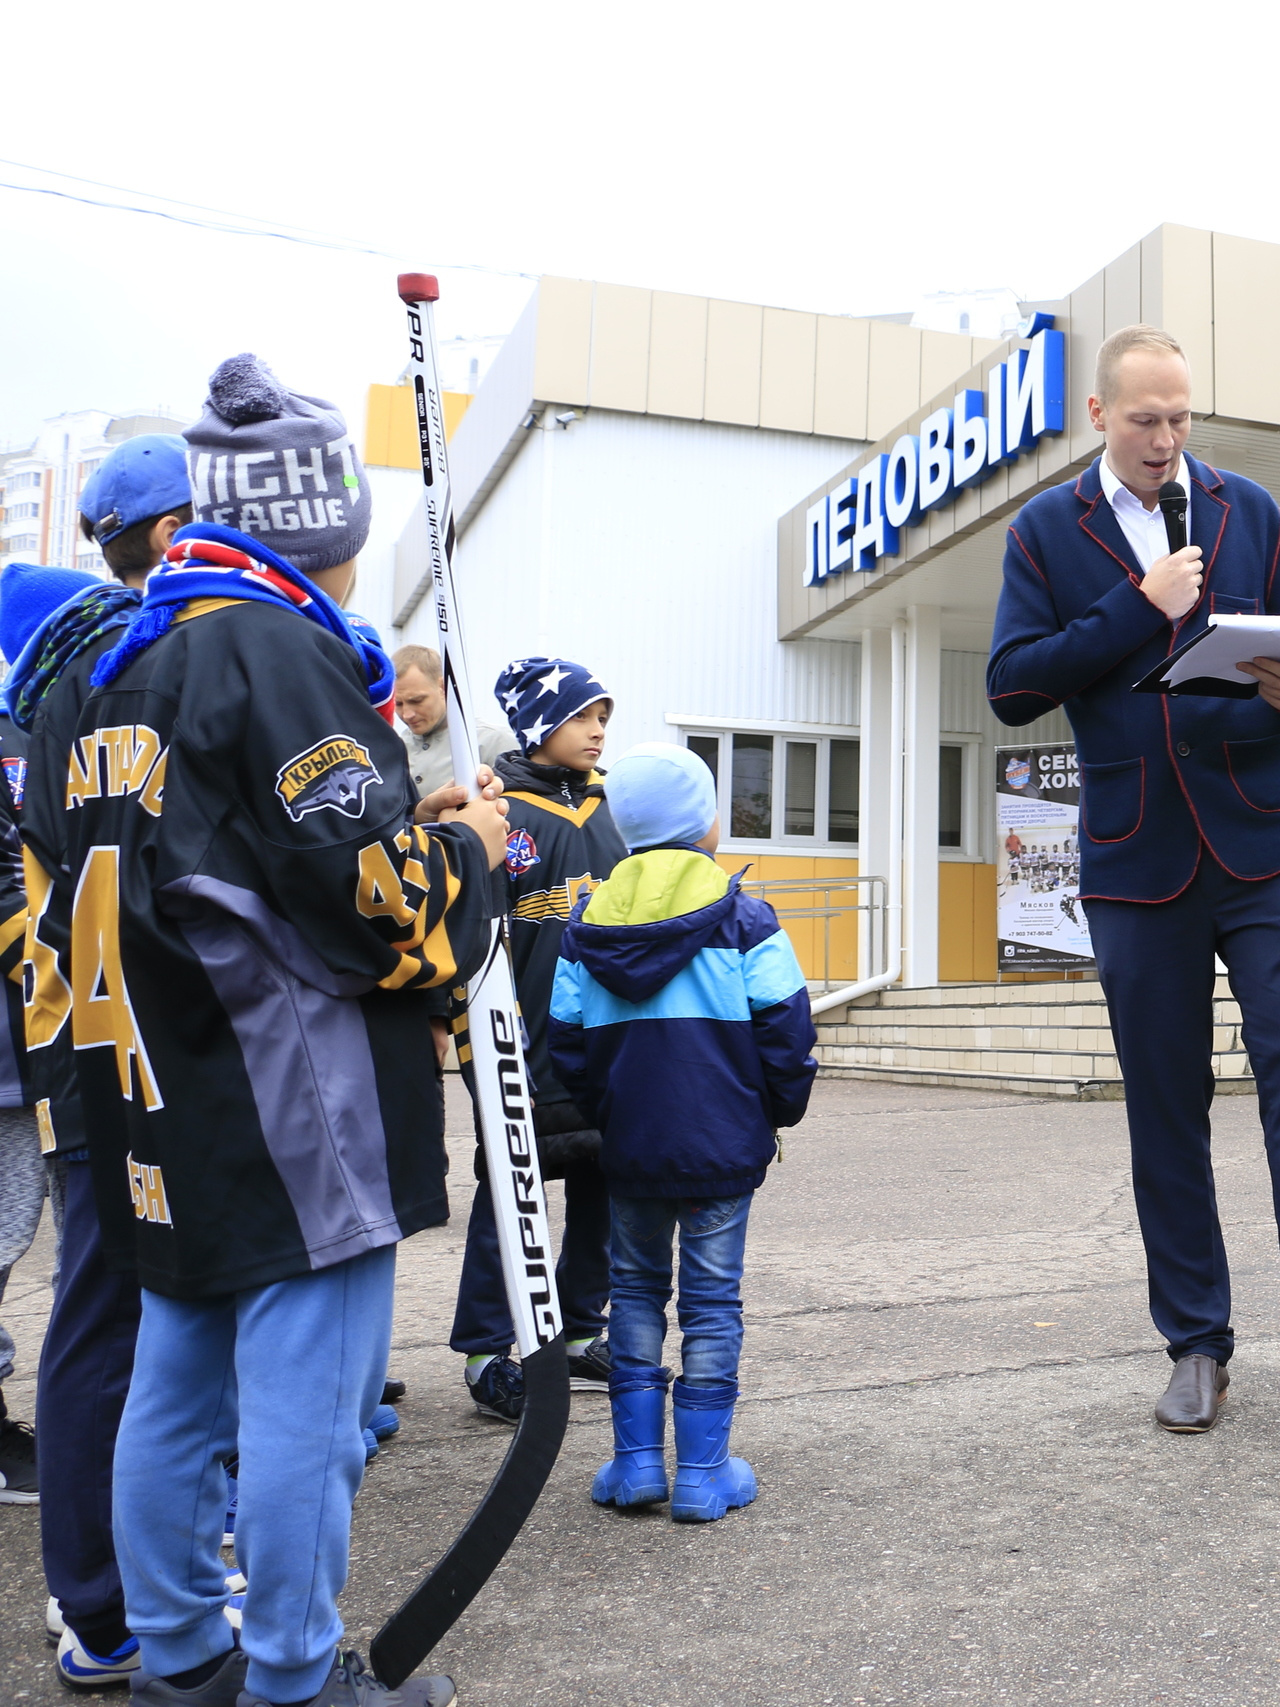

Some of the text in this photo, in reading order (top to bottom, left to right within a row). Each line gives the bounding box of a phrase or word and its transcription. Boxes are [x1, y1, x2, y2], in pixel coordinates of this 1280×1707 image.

[185, 436, 361, 508] NIGHT
[802, 311, 1064, 587] ЛЕДОВЫЙ
[426, 496, 444, 588] SUPREME
[288, 744, 358, 786] КРЫЛЬЯ
[1038, 754, 1079, 771] СЕК
[1039, 772, 1080, 789] ХОК
[490, 1009, 556, 1349] SUPREME
